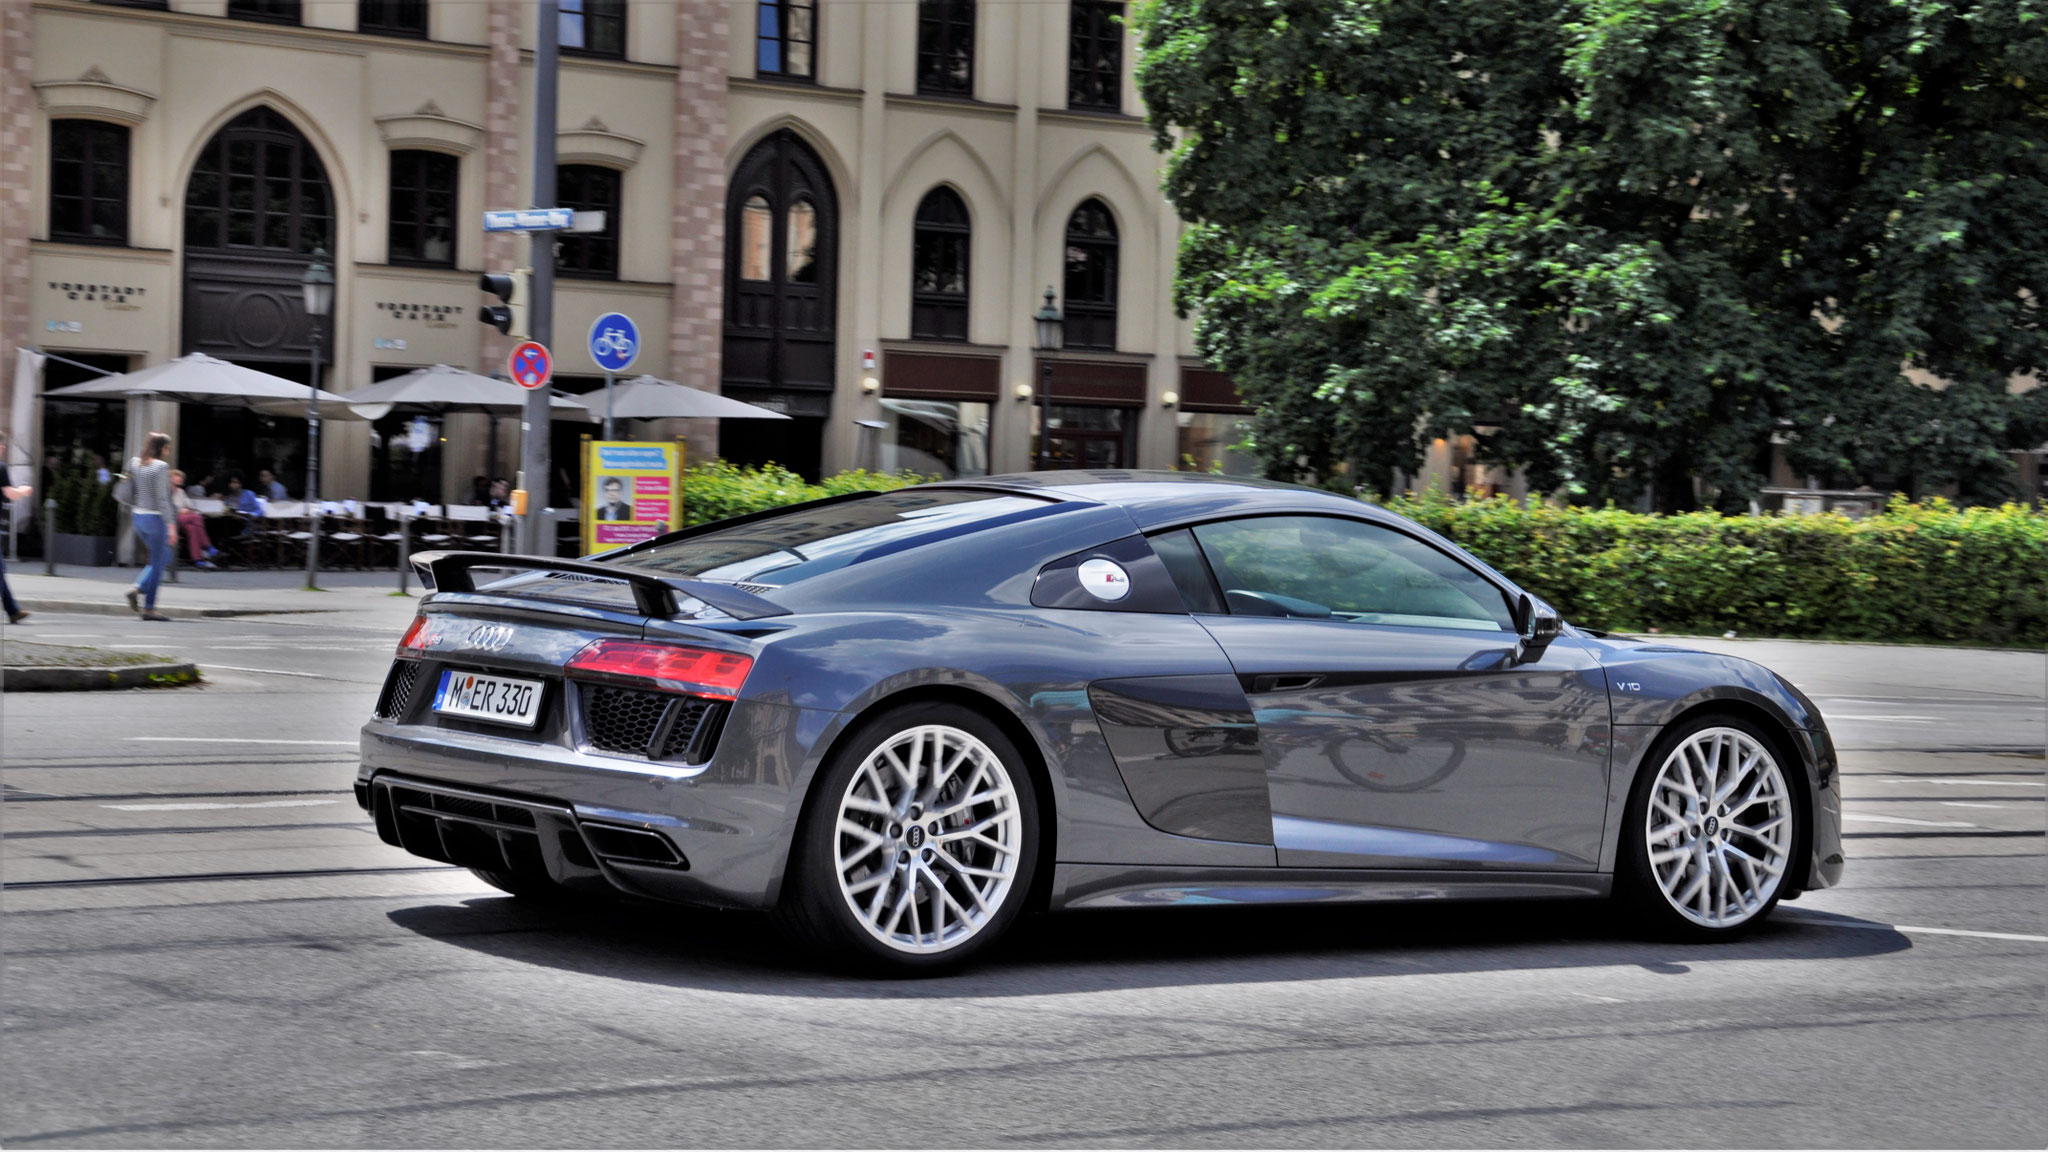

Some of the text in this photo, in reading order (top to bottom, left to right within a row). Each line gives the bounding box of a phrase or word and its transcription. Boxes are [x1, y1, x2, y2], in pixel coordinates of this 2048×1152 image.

[48, 281, 147, 296] VORSTADT
[375, 302, 463, 314] VORSTADT
[449, 677, 533, 717] M ER 330
